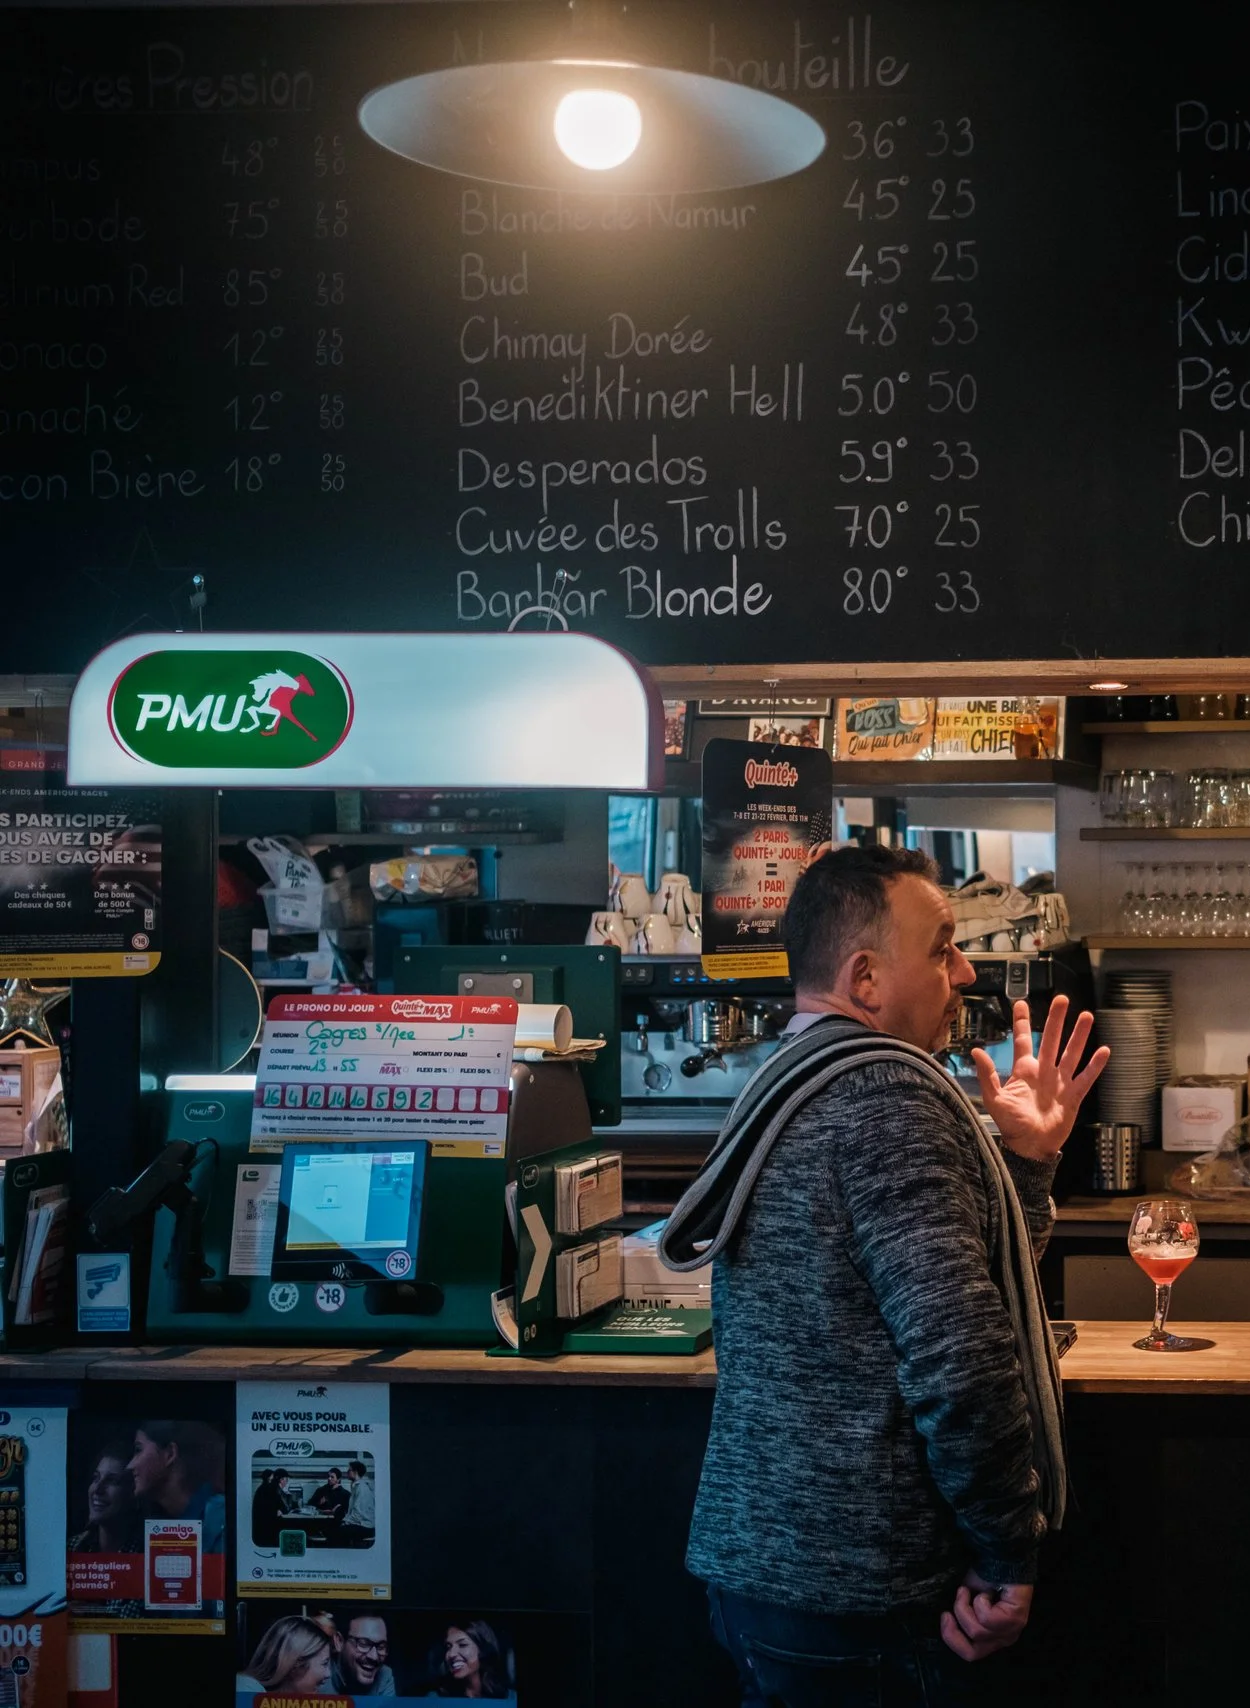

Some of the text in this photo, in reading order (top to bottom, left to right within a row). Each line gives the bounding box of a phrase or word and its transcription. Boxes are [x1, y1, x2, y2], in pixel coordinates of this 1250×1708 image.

[710, 15, 909, 89] bouteille
[147, 41, 314, 110] Pression
[926, 116, 975, 157] 33
[927, 178, 976, 221] 25
[460, 188, 592, 236] Blanche
[460, 251, 529, 301] Bud
[930, 240, 979, 282] 25
[126, 262, 184, 307] Red
[460, 315, 587, 384] Chimay
[604, 312, 712, 360] Dorée
[932, 302, 979, 346] 33
[458, 364, 709, 427] Benediktiner
[729, 362, 804, 422] Hell
[926, 370, 978, 413] 50
[319, 393, 345, 413] 25
[318, 411, 345, 430] 50
[321, 453, 346, 473] 25
[90, 448, 205, 500] Bière
[458, 434, 708, 515] Desperados
[930, 440, 980, 481] 33
[320, 472, 346, 493] 50
[455, 505, 586, 556] Cuvée
[595, 498, 659, 553] des
[666, 486, 788, 554] Trolls
[935, 504, 981, 549] 25
[620, 554, 772, 617] Blonde
[935, 569, 982, 613] 33
[135, 693, 247, 732] PMU
[967, 700, 997, 713] UNE
[954, 716, 982, 727] FAIT
[848, 736, 869, 756] Qui
[870, 733, 891, 753] fait
[8, 761, 46, 769] GRAND
[745, 758, 799, 788] Quinté+
[747, 804, 786, 813] LES WEEK-ENDS
[15, 813, 134, 829] PARTICIPEZ,
[37, 832, 85, 846] AVEZ
[89, 832, 113, 846] DE
[754, 831, 789, 843] 2 PARIS
[27, 850, 52, 864] DE
[778, 845, 808, 860] JOUÉS
[764, 881, 785, 892] PARI
[15, 891, 66, 902] Des chèques
[94, 891, 135, 899] Des bonus
[762, 896, 788, 909] SPOT
[7, 900, 54, 909] cadeaux de
[98, 900, 109, 908] de
[750, 920, 776, 928] AMÉRIQUE
[284, 1003, 375, 1013] LE PRONO DU JOUR
[423, 1004, 452, 1018] MAX
[305, 1020, 367, 1046] Cagnes
[340, 1058, 359, 1073] 55
[380, 1066, 401, 1075] MAX
[263, 1089, 280, 1108] 16
[286, 1090, 299, 1108] 4
[306, 1090, 323, 1108] 12
[328, 1090, 345, 1108] 14
[376, 1091, 389, 1109] 5
[394, 1091, 408, 1109] 9
[418, 1091, 432, 1109] 2
[390, 1257, 406, 1270] -18
[319, 1287, 341, 1305] -18
[297, 1389, 315, 1398] PMU
[251, 1411, 347, 1422] AVEC VOUS POUR
[30, 1424, 41, 1432] 5€
[251, 1423, 267, 1432] UN
[270, 1424, 290, 1433] JEU
[275, 1441, 299, 1451] PMU
[162, 1524, 193, 1538] amigo
[90, 1560, 131, 1573] réguliers
[74, 1571, 110, 1583] au long
[70, 1581, 108, 1592] journée
[259, 1697, 349, 1708] ANIMATION
